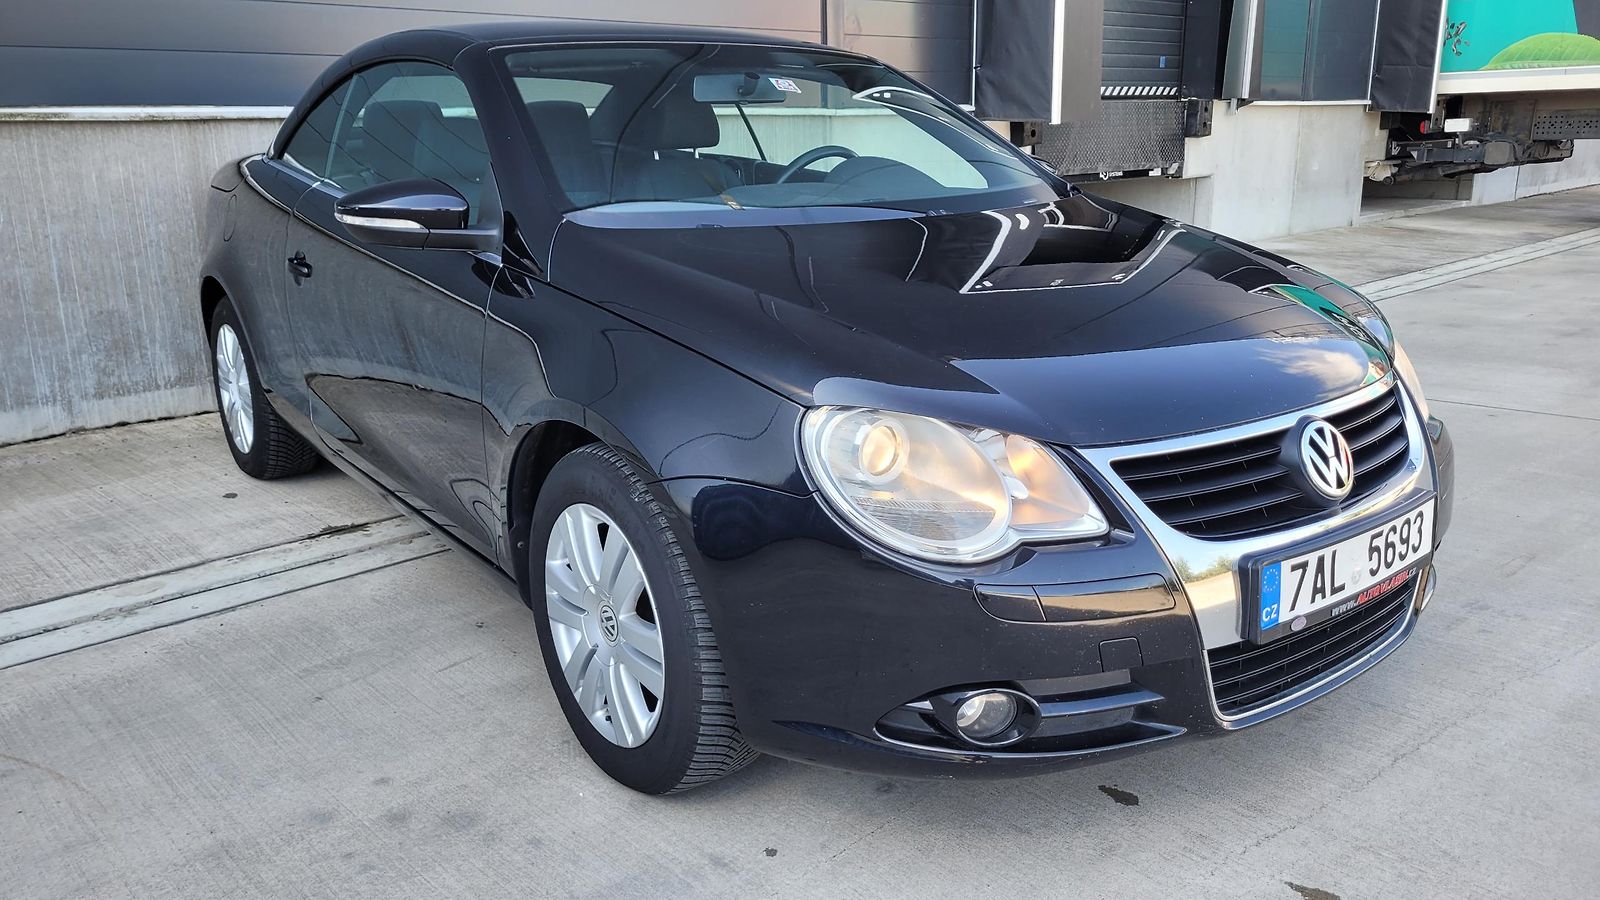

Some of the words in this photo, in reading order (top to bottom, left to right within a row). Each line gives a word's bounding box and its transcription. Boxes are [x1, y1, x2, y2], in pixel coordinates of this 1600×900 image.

[1301, 420, 1353, 497] VW
[1288, 549, 1346, 613] 7AL
[1367, 510, 1424, 577] 5693
[1262, 603, 1277, 622] CZ
